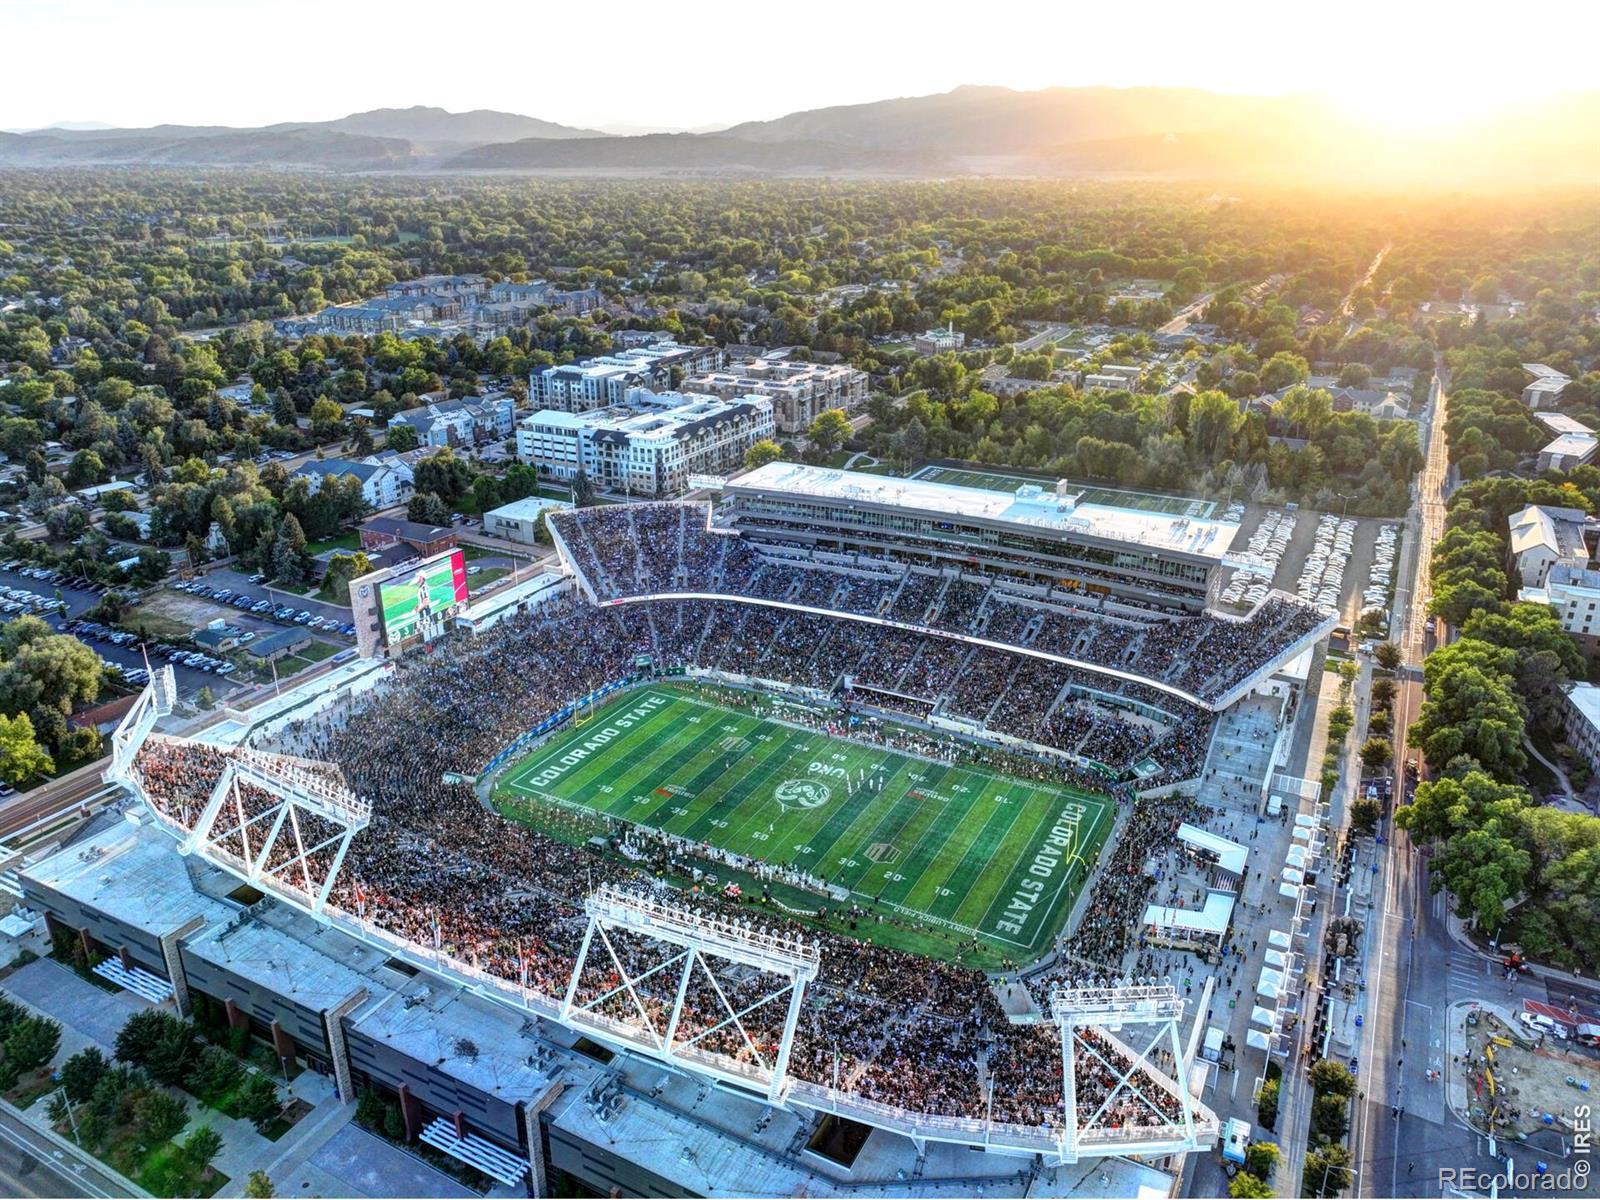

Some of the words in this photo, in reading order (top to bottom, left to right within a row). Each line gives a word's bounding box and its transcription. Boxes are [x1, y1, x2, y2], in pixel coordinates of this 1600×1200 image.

[530, 727, 620, 788] COLORADO
[615, 695, 666, 729] STATE
[752, 831, 769, 841] 50
[1029, 802, 1087, 882] COLORADO
[883, 871, 901, 882] 20
[936, 886, 951, 896] 10
[996, 877, 1046, 936] STATE
